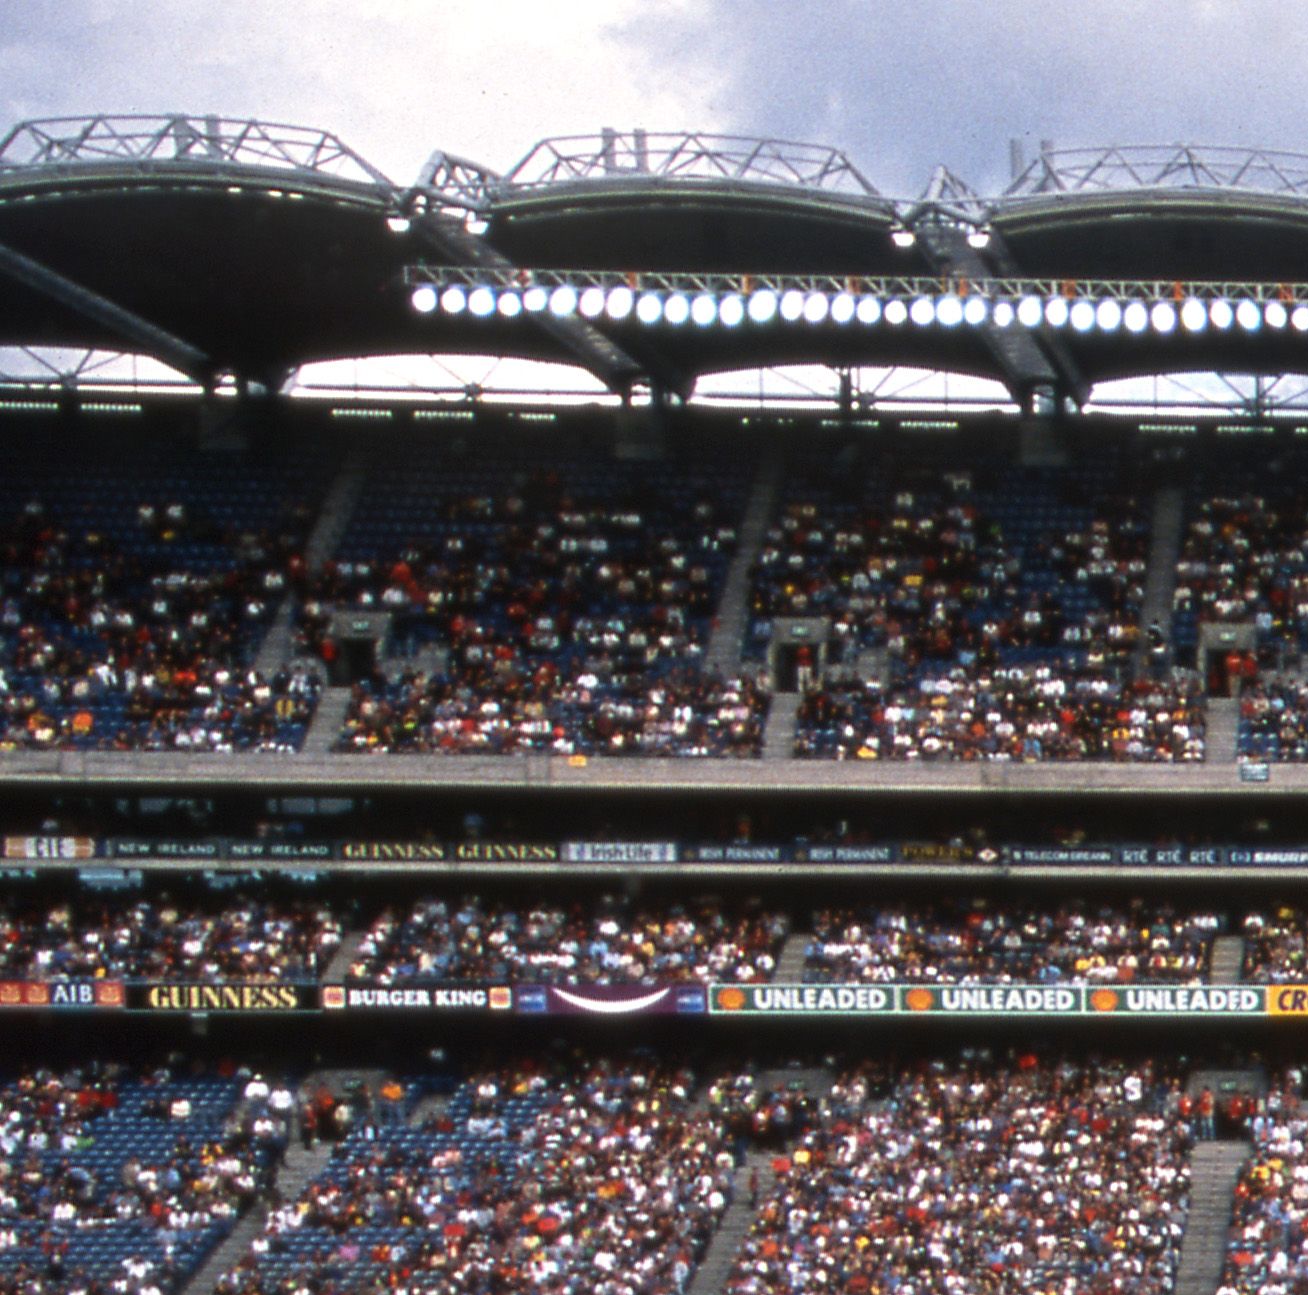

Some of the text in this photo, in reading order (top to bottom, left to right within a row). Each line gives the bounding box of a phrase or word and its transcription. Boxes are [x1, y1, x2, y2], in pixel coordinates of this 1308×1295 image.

[118, 844, 216, 855] NEW IRELAND
[232, 844, 329, 855] NEW IRELAND
[343, 843, 444, 859] GUINNESS
[458, 844, 556, 860] GUINNESS
[52, 985, 92, 1003] AIB
[149, 985, 297, 1009] GUINNESS
[349, 989, 487, 1006] BURGER KING
[754, 990, 887, 1009] UNLEADED
[941, 990, 1075, 1010] UNLEADED
[1127, 991, 1259, 1010] UNLEADED
